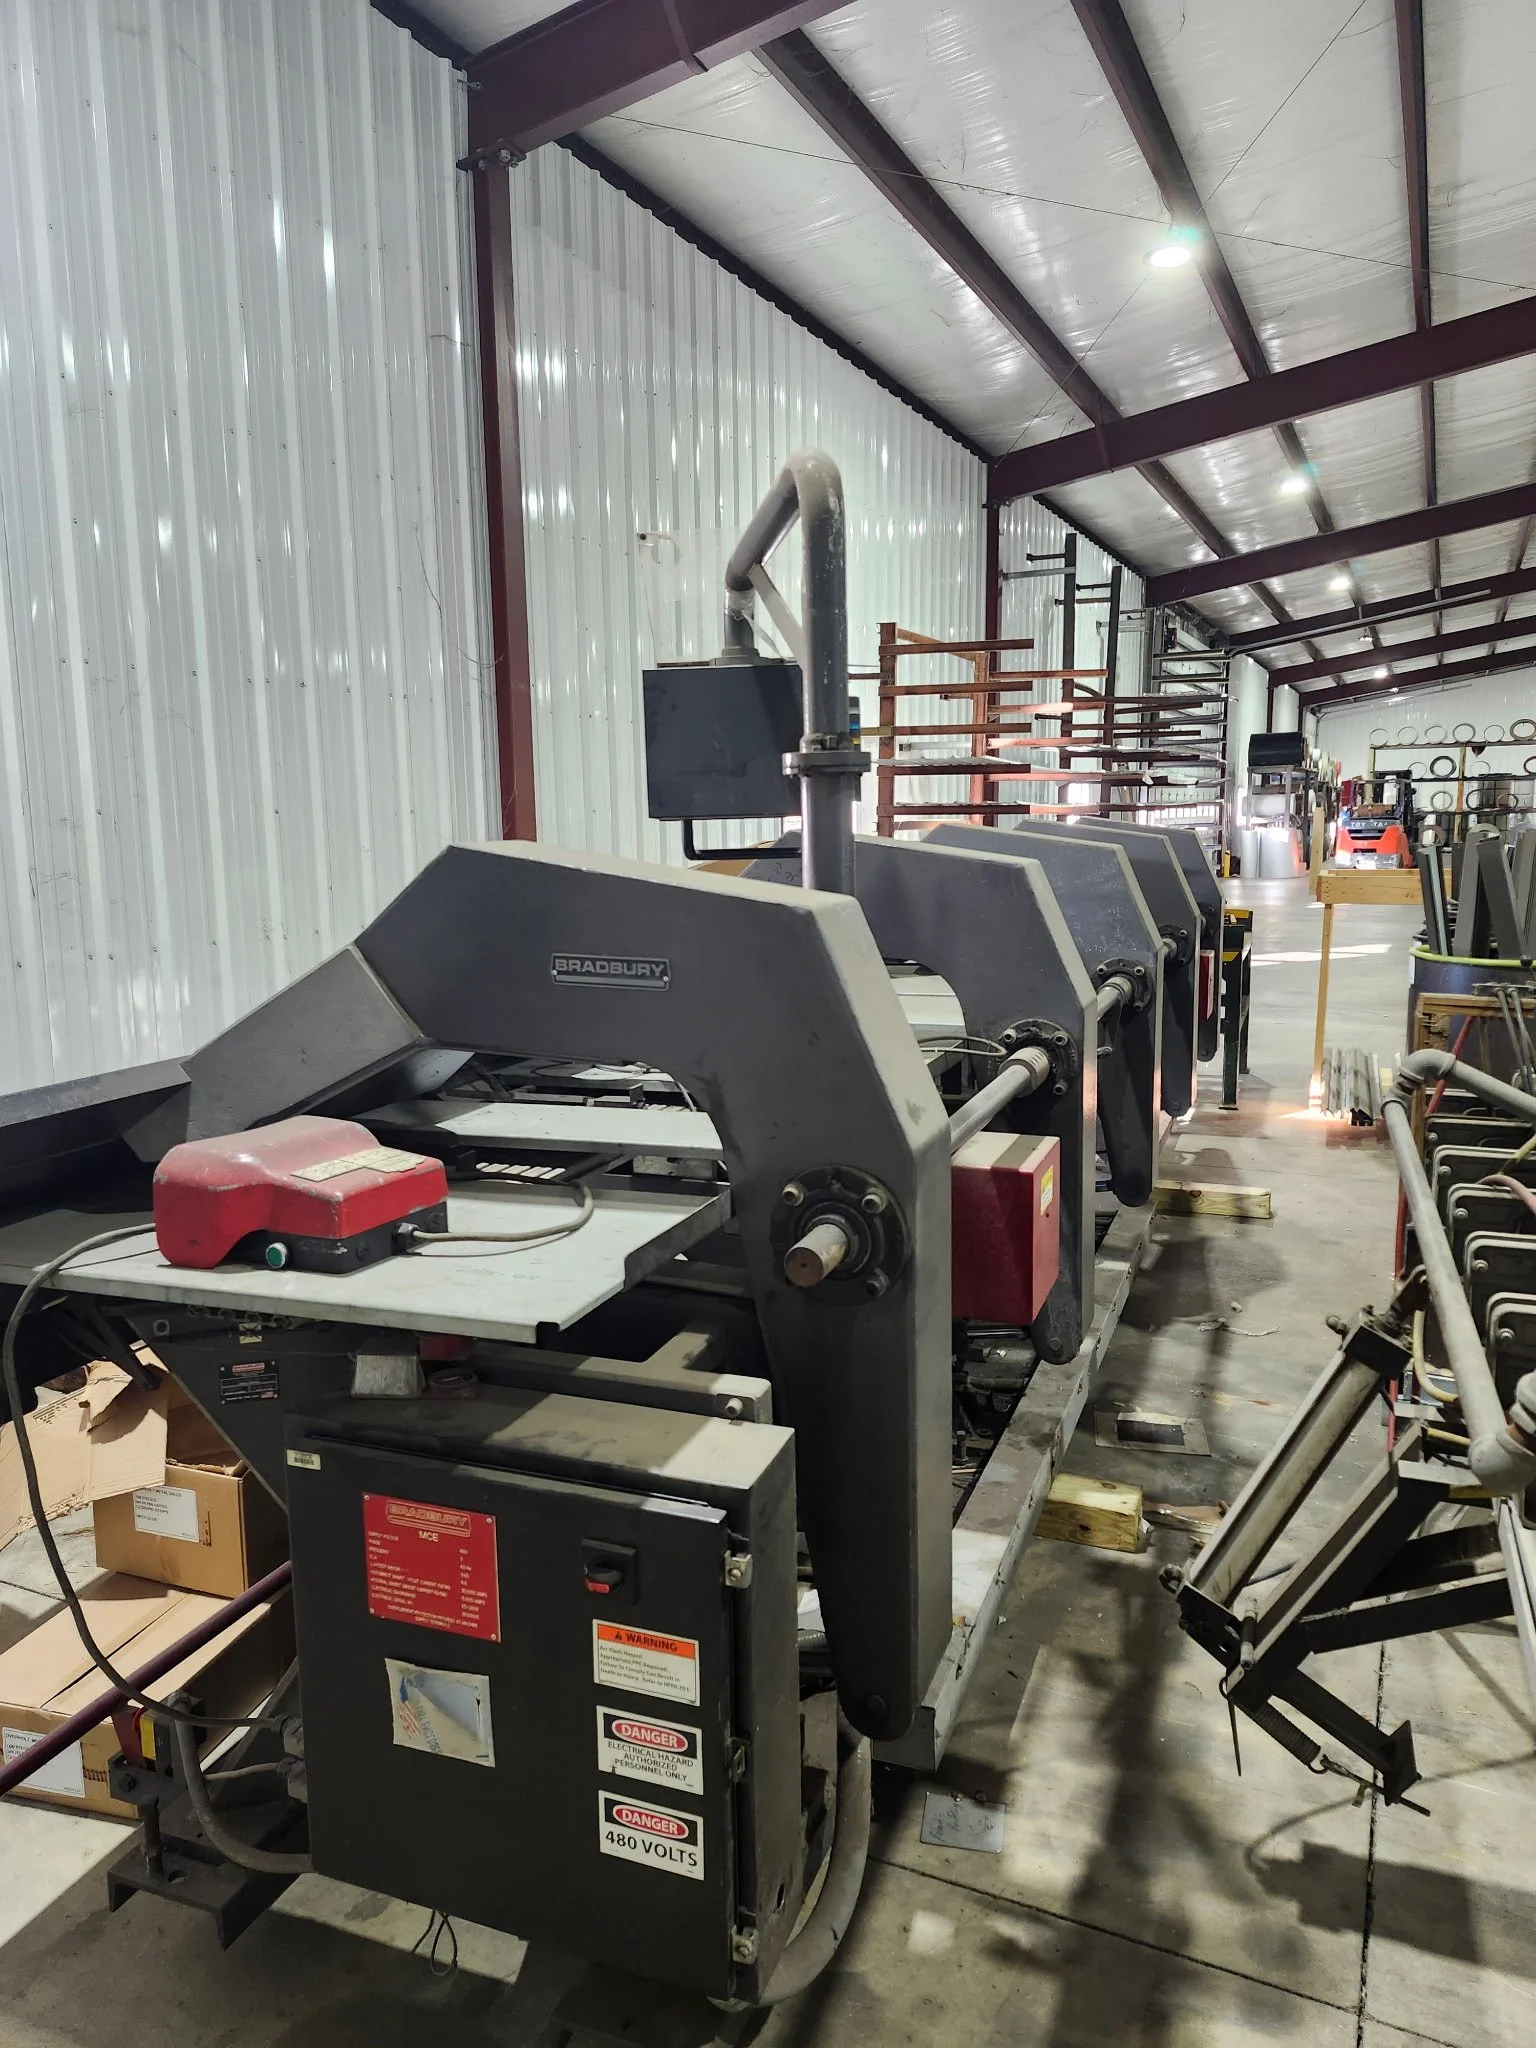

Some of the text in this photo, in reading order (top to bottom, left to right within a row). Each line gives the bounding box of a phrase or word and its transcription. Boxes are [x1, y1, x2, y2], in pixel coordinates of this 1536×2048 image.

[555, 958, 664, 977] BRADBURY
[389, 1503, 469, 1527] BRADBURY
[418, 1531, 439, 1543] MCE
[609, 1647, 622, 1655] Flash
[626, 1633, 677, 1652] WARNING
[600, 1660, 618, 1669] Failure
[625, 1666, 646, 1676] Comply
[657, 1672, 674, 1681] Result
[621, 1724, 678, 1748] DANGER
[608, 1741, 693, 1767] ELECTRICAL HAZARD
[624, 1753, 678, 1771] AUTHORIZED
[614, 1759, 687, 1782] PERSONNEL ONLY
[622, 1809, 678, 1835] DANGER
[605, 1830, 698, 1867] 480 VOLTS
